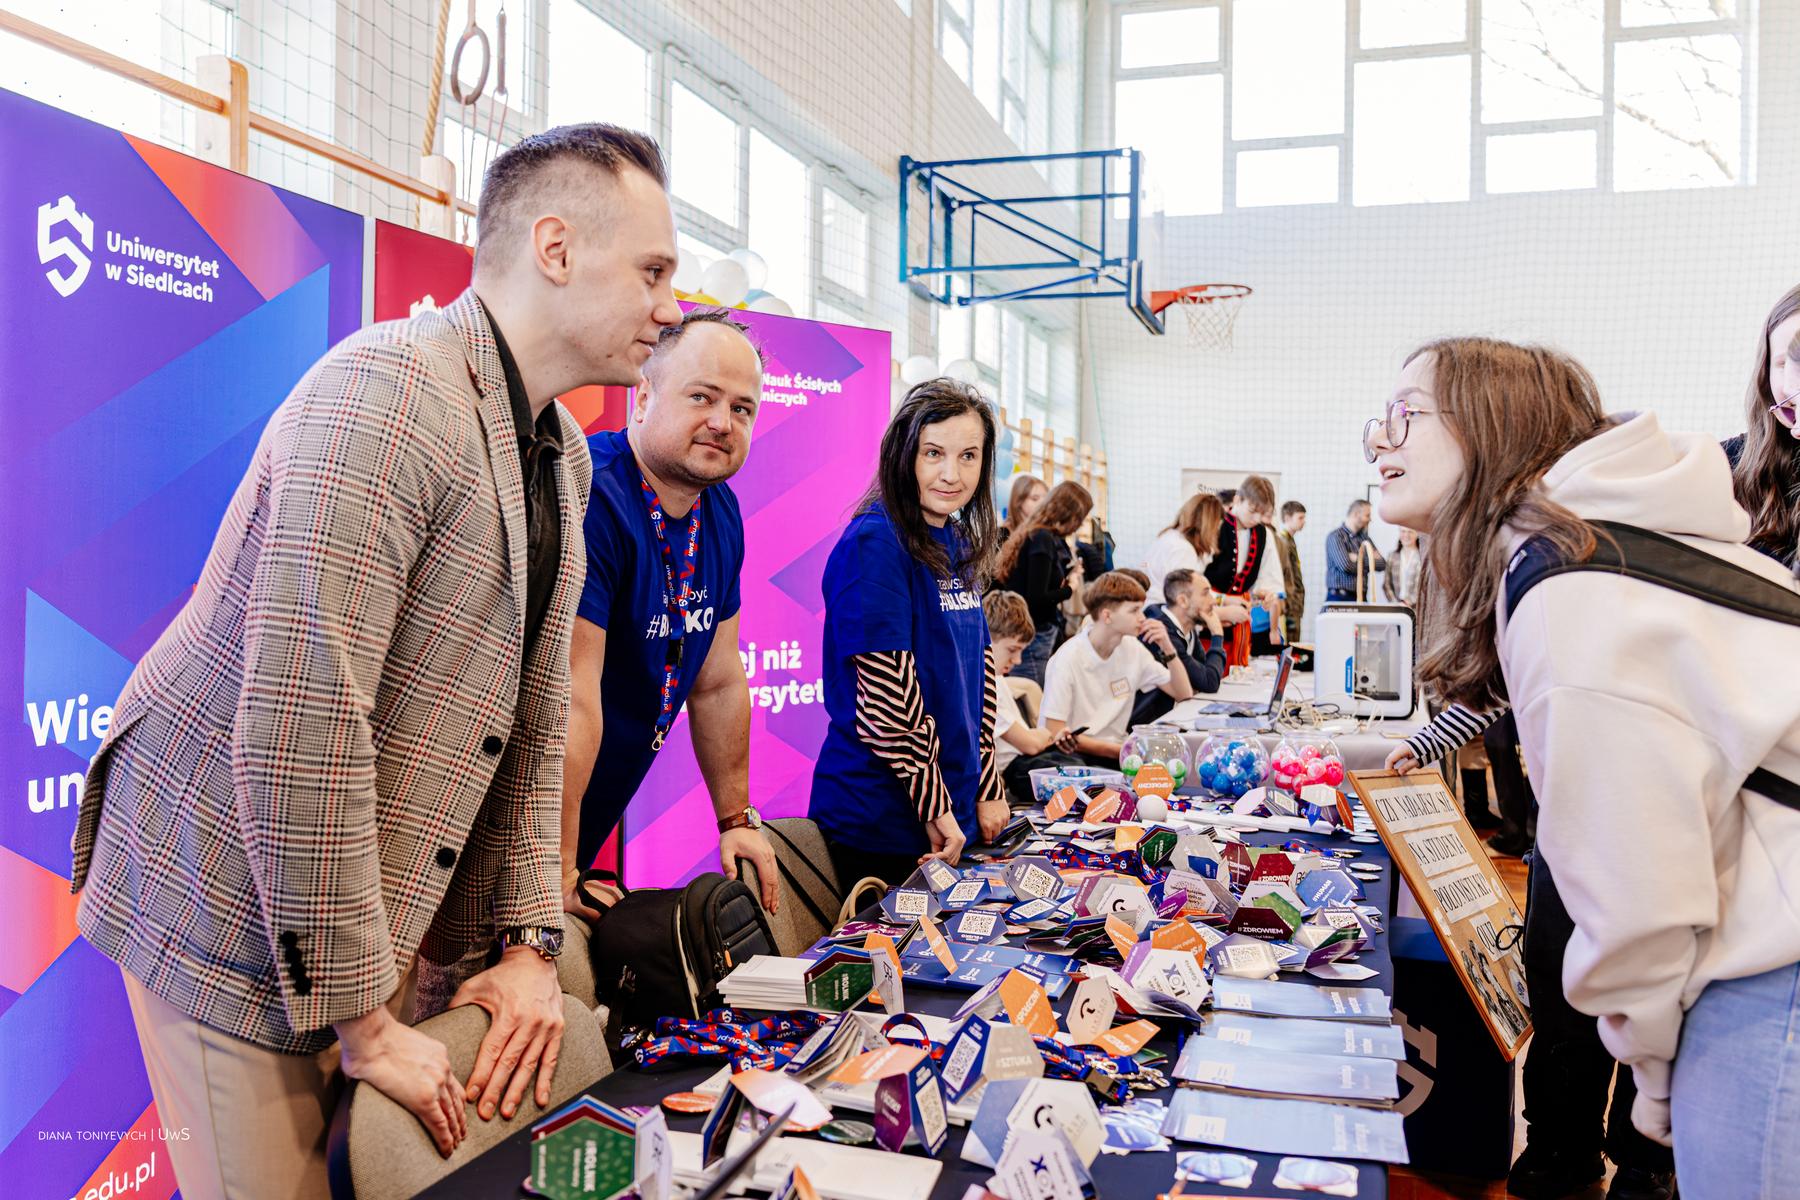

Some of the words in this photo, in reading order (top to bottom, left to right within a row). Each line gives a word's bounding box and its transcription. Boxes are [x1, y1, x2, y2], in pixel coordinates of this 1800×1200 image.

[106, 230, 219, 279] Uniwersytet
[105, 261, 121, 281] w
[126, 265, 213, 303] Siedlcach
[761, 389, 807, 408] niczych
[794, 372, 842, 395] Ścisłych
[762, 641, 802, 670] niż
[750, 678, 824, 713] rsytet
[1375, 798, 1399, 823] CZY
[1408, 842, 1430, 866] NA
[1422, 834, 1467, 862] STUDENTA
[1237, 926, 1284, 934] #ZDROWIEM
[82, 1152, 156, 1200] edu.pl
[584, 1139, 598, 1192] #ROLNIK
